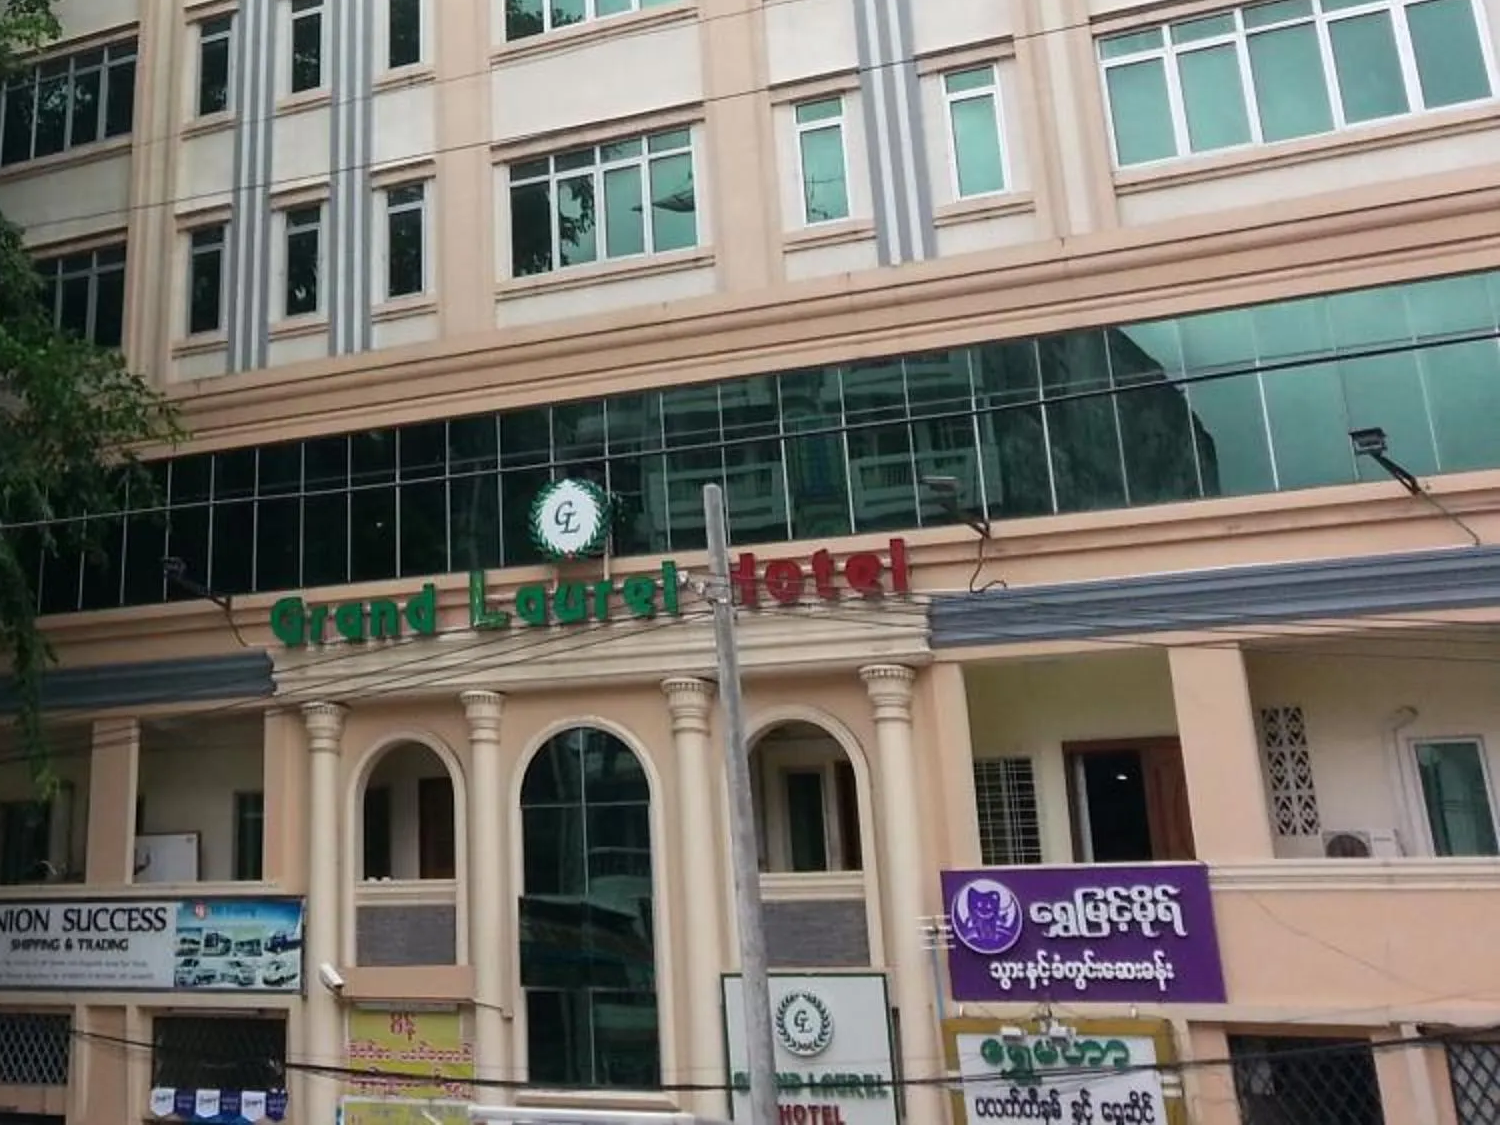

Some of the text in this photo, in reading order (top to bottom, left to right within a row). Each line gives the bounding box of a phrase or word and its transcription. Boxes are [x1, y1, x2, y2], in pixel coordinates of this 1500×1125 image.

[270, 583, 436, 647] Grand
[469, 560, 679, 631] Laurel
[62, 906, 167, 933] SUCCESS
[10, 937, 61, 952] SHIPPING
[78, 937, 129, 952] TRADING
[777, 1103, 848, 1125] HOTEL
